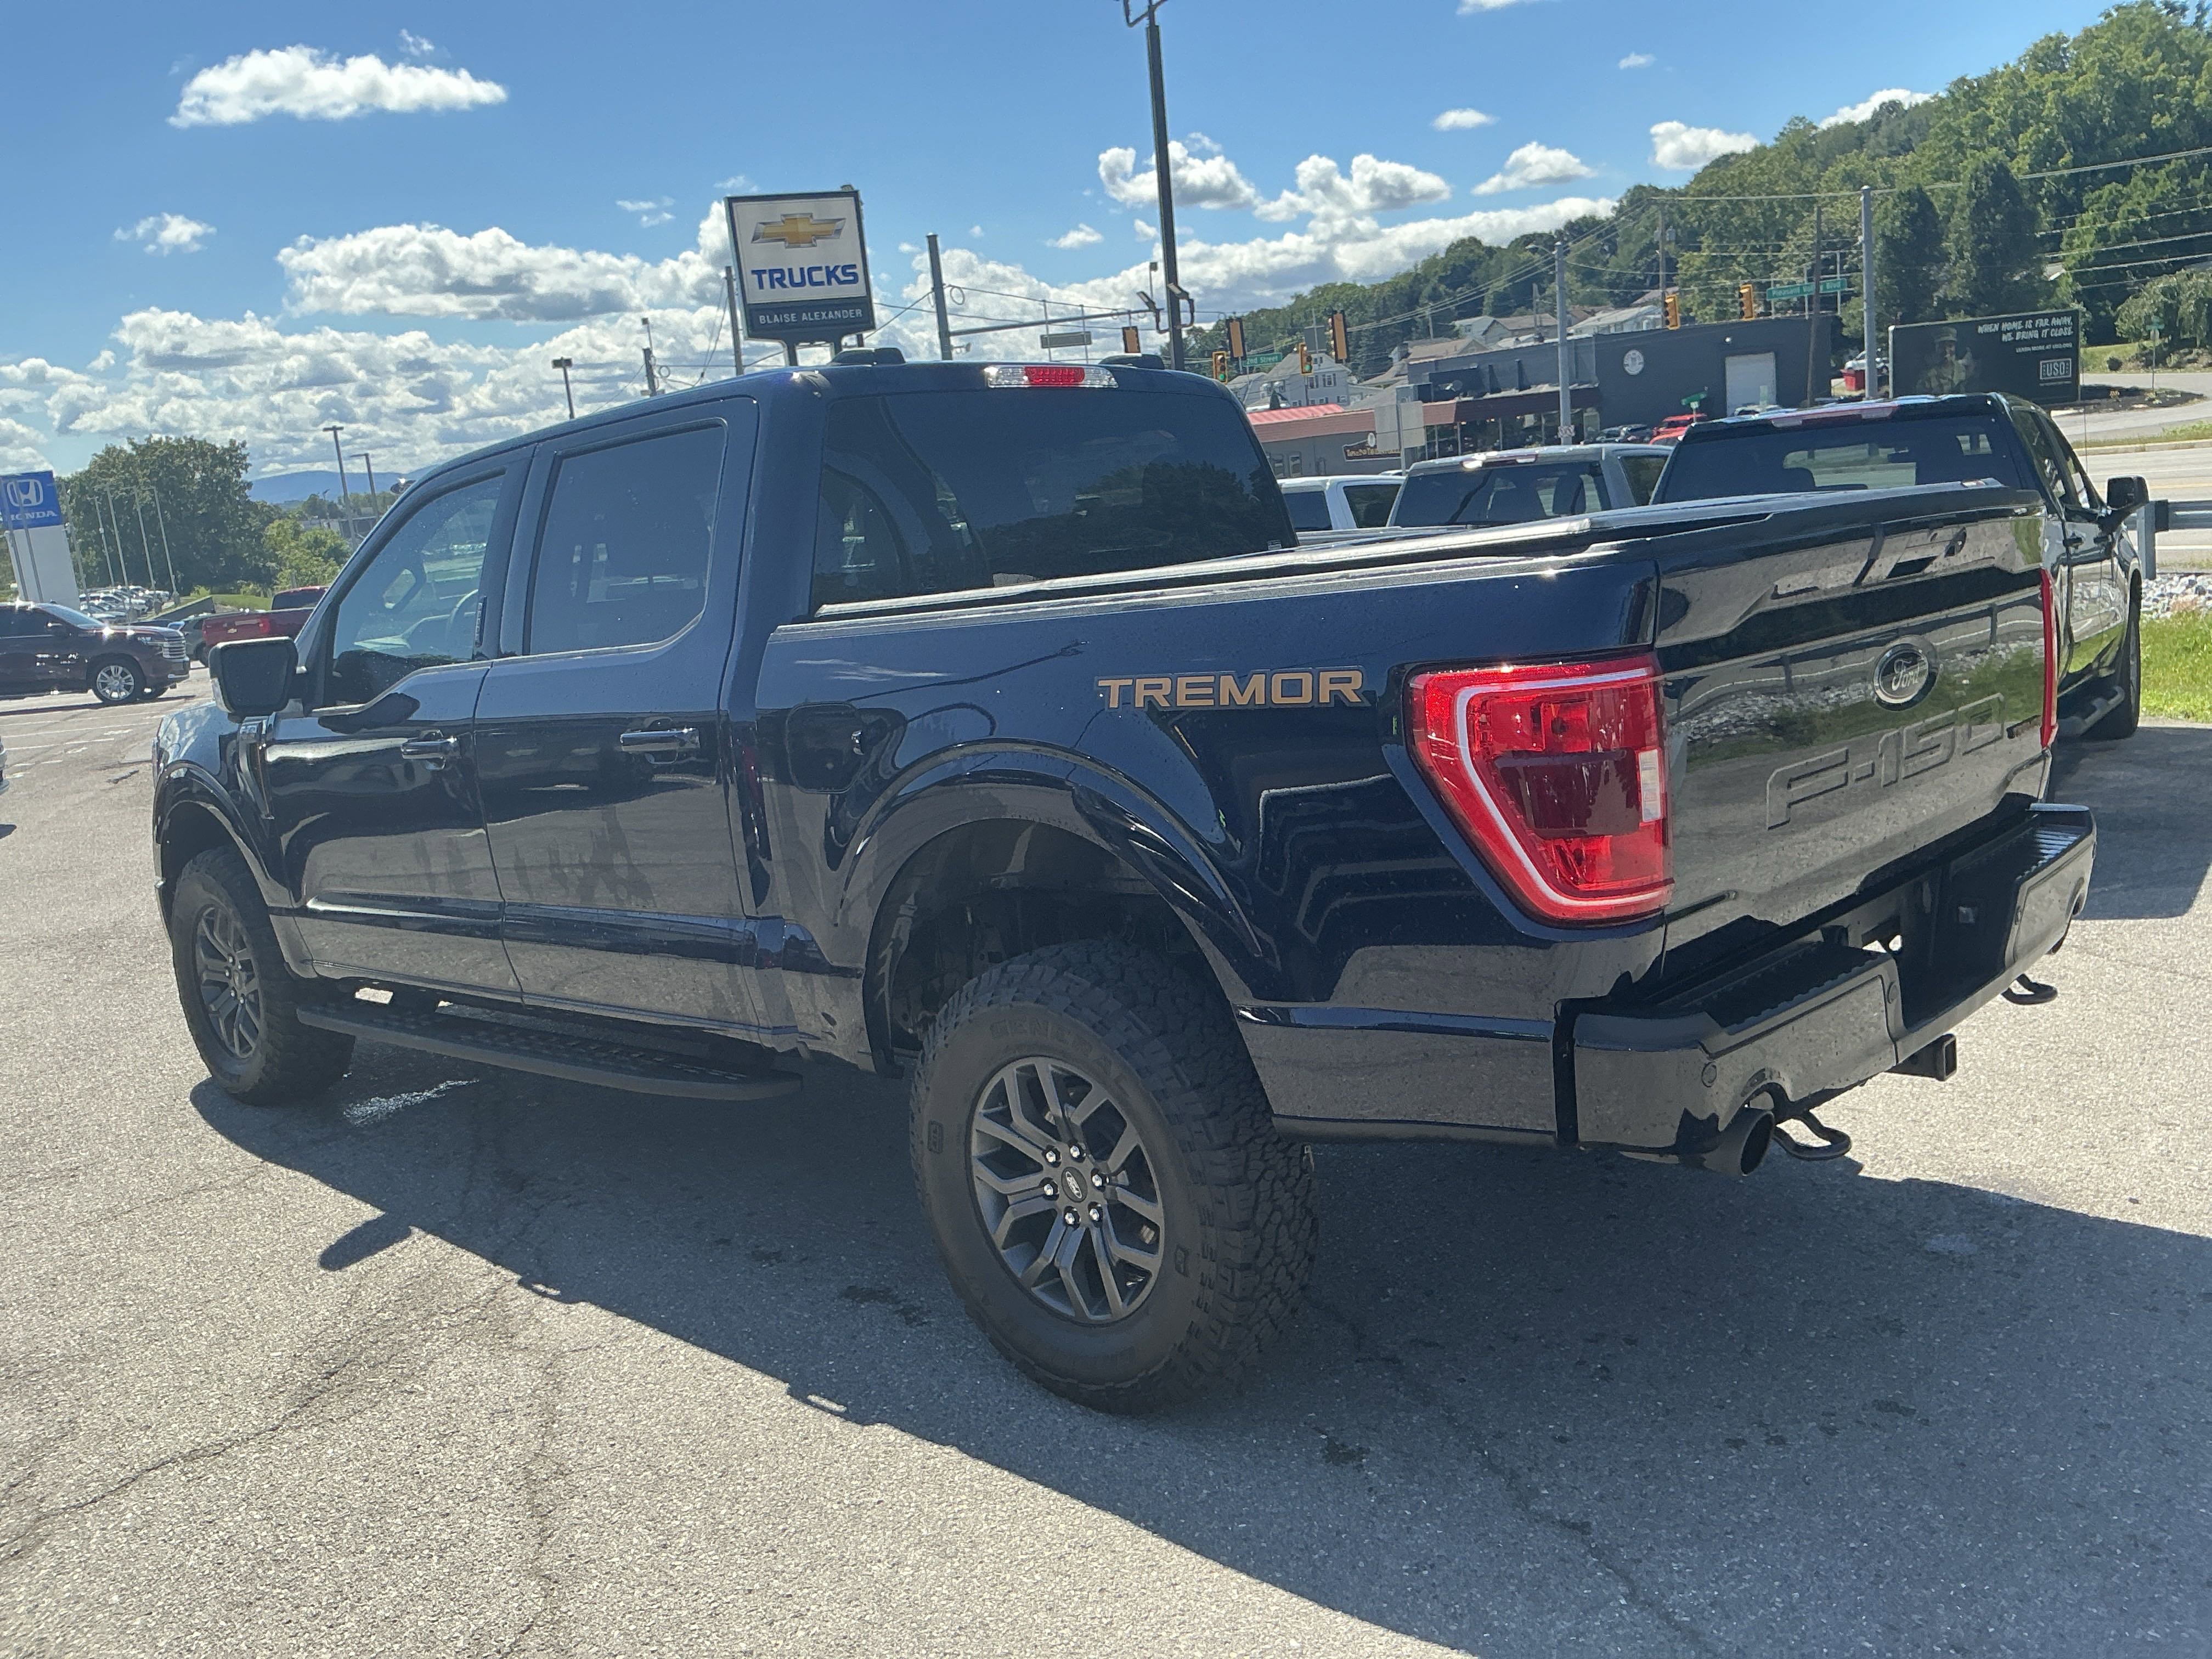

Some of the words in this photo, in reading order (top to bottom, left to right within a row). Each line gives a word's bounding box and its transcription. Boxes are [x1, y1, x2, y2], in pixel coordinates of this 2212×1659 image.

[751, 263, 859, 290] TRUCKS
[759, 313, 798, 324] BLAISE
[802, 309, 862, 322] ALEXANDER
[1977, 323, 2000, 334] WHEN
[2001, 320, 2024, 331] HOME
[2025, 319, 2033, 329] IS
[2035, 318, 2050, 328] FAR
[2002, 332, 2015, 342] WE
[2016, 330, 2039, 340] BRING
[2041, 328, 2050, 338] IT
[2046, 362, 2066, 376] USO
[1891, 659, 1921, 691] Ford
[1098, 670, 1364, 708] TREMOR
[1767, 692, 2005, 830] F-150
